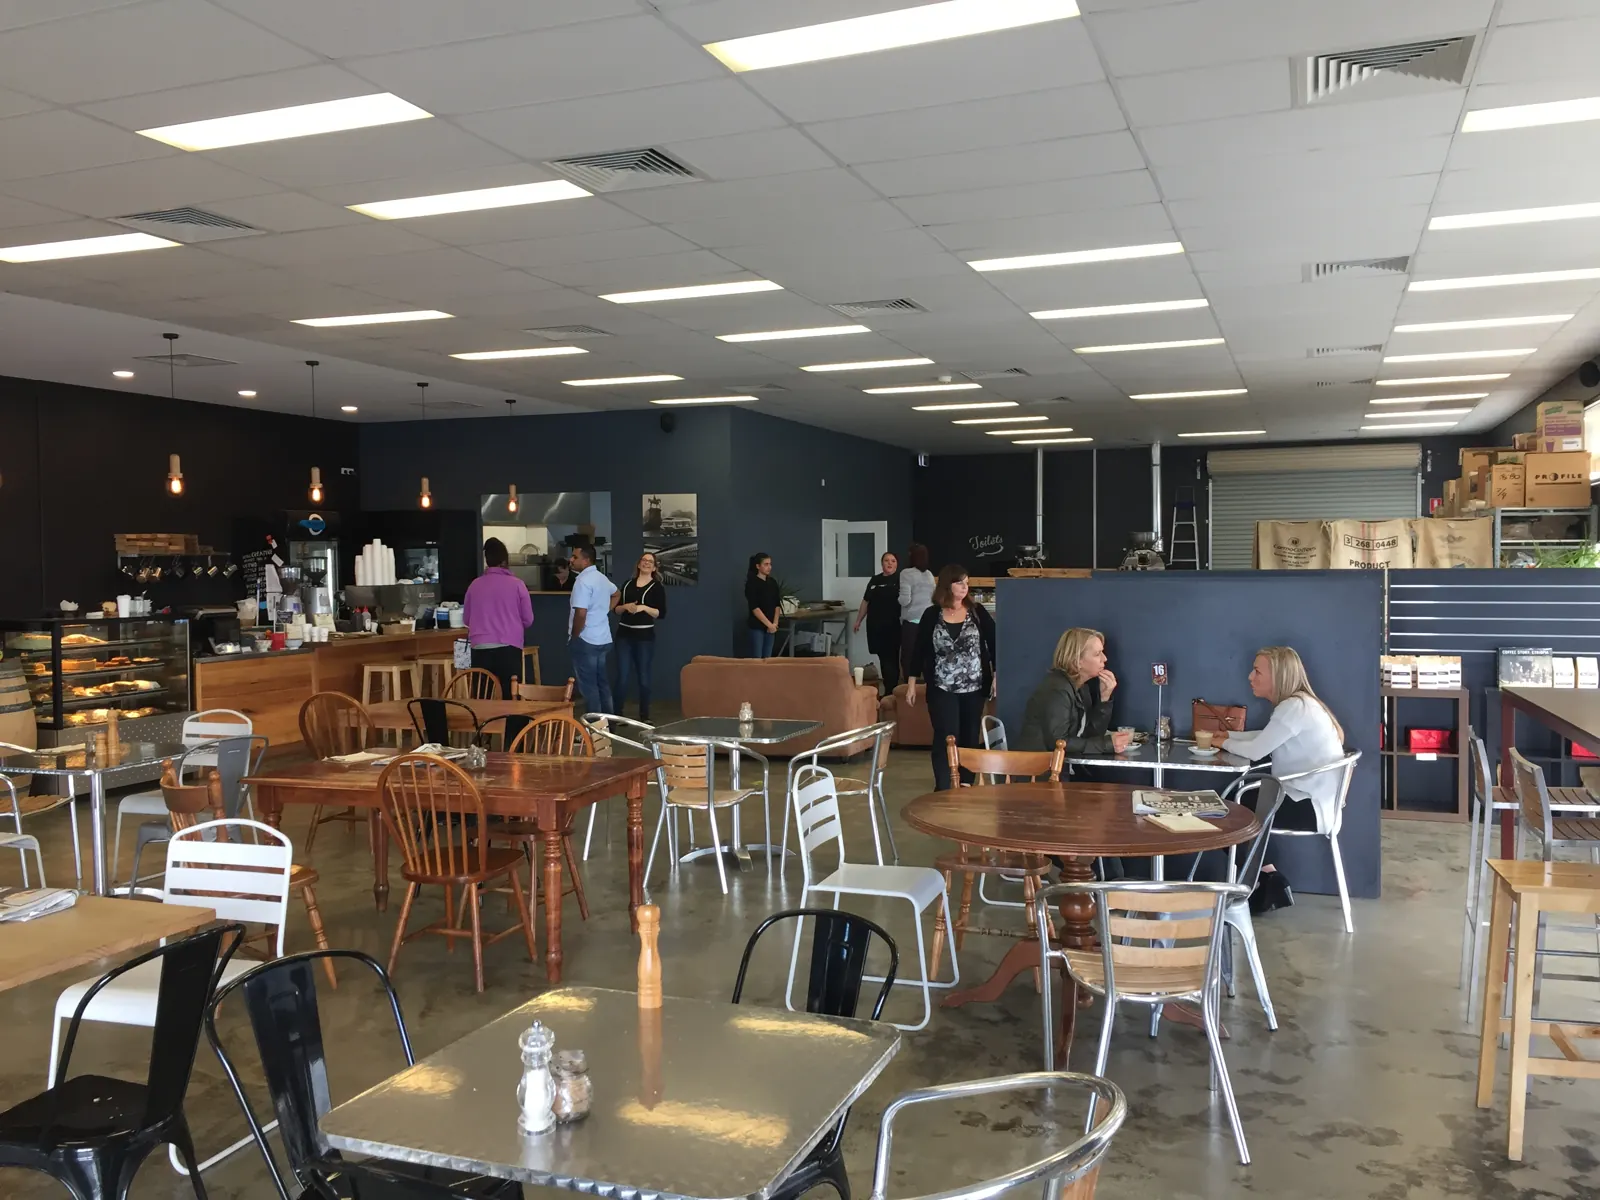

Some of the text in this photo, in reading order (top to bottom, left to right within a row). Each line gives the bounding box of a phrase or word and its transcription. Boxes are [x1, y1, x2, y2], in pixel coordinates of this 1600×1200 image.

[1534, 472, 1583, 481] PROFILE
[968, 534, 1003, 550] Toilets
[1355, 539, 1371, 549] 268
[1375, 539, 1397, 549] 0448
[1349, 559, 1391, 569] PRODUCT
[1153, 664, 1165, 676] 16
